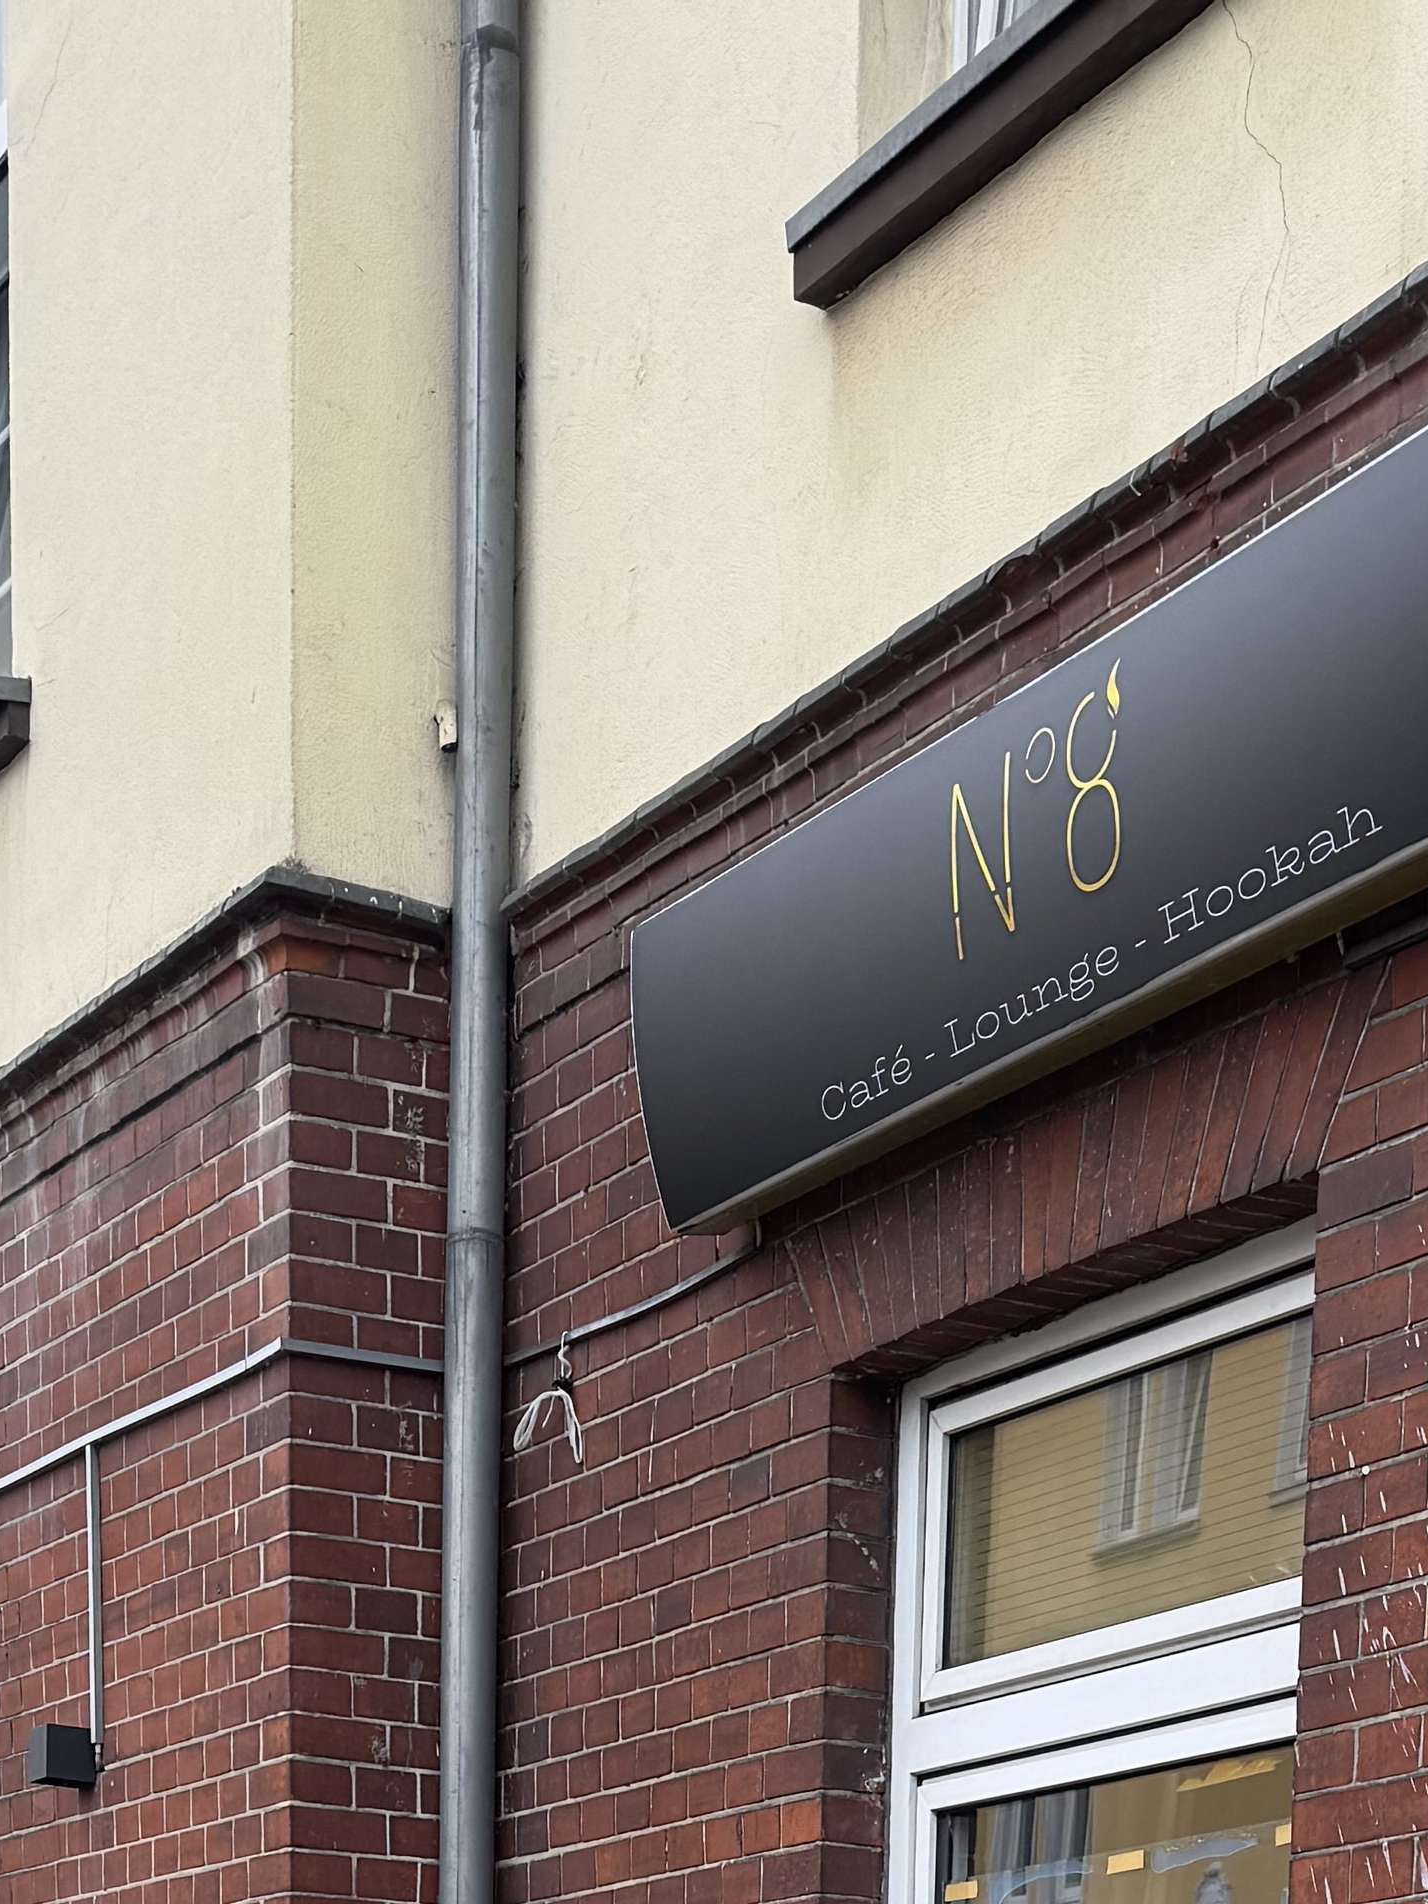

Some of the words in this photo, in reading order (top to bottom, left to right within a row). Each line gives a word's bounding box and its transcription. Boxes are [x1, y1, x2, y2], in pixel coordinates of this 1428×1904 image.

[821, 1044, 912, 1121] Café
[943, 944, 1121, 1059] Lounge
[1158, 805, 1383, 945] Hookah
